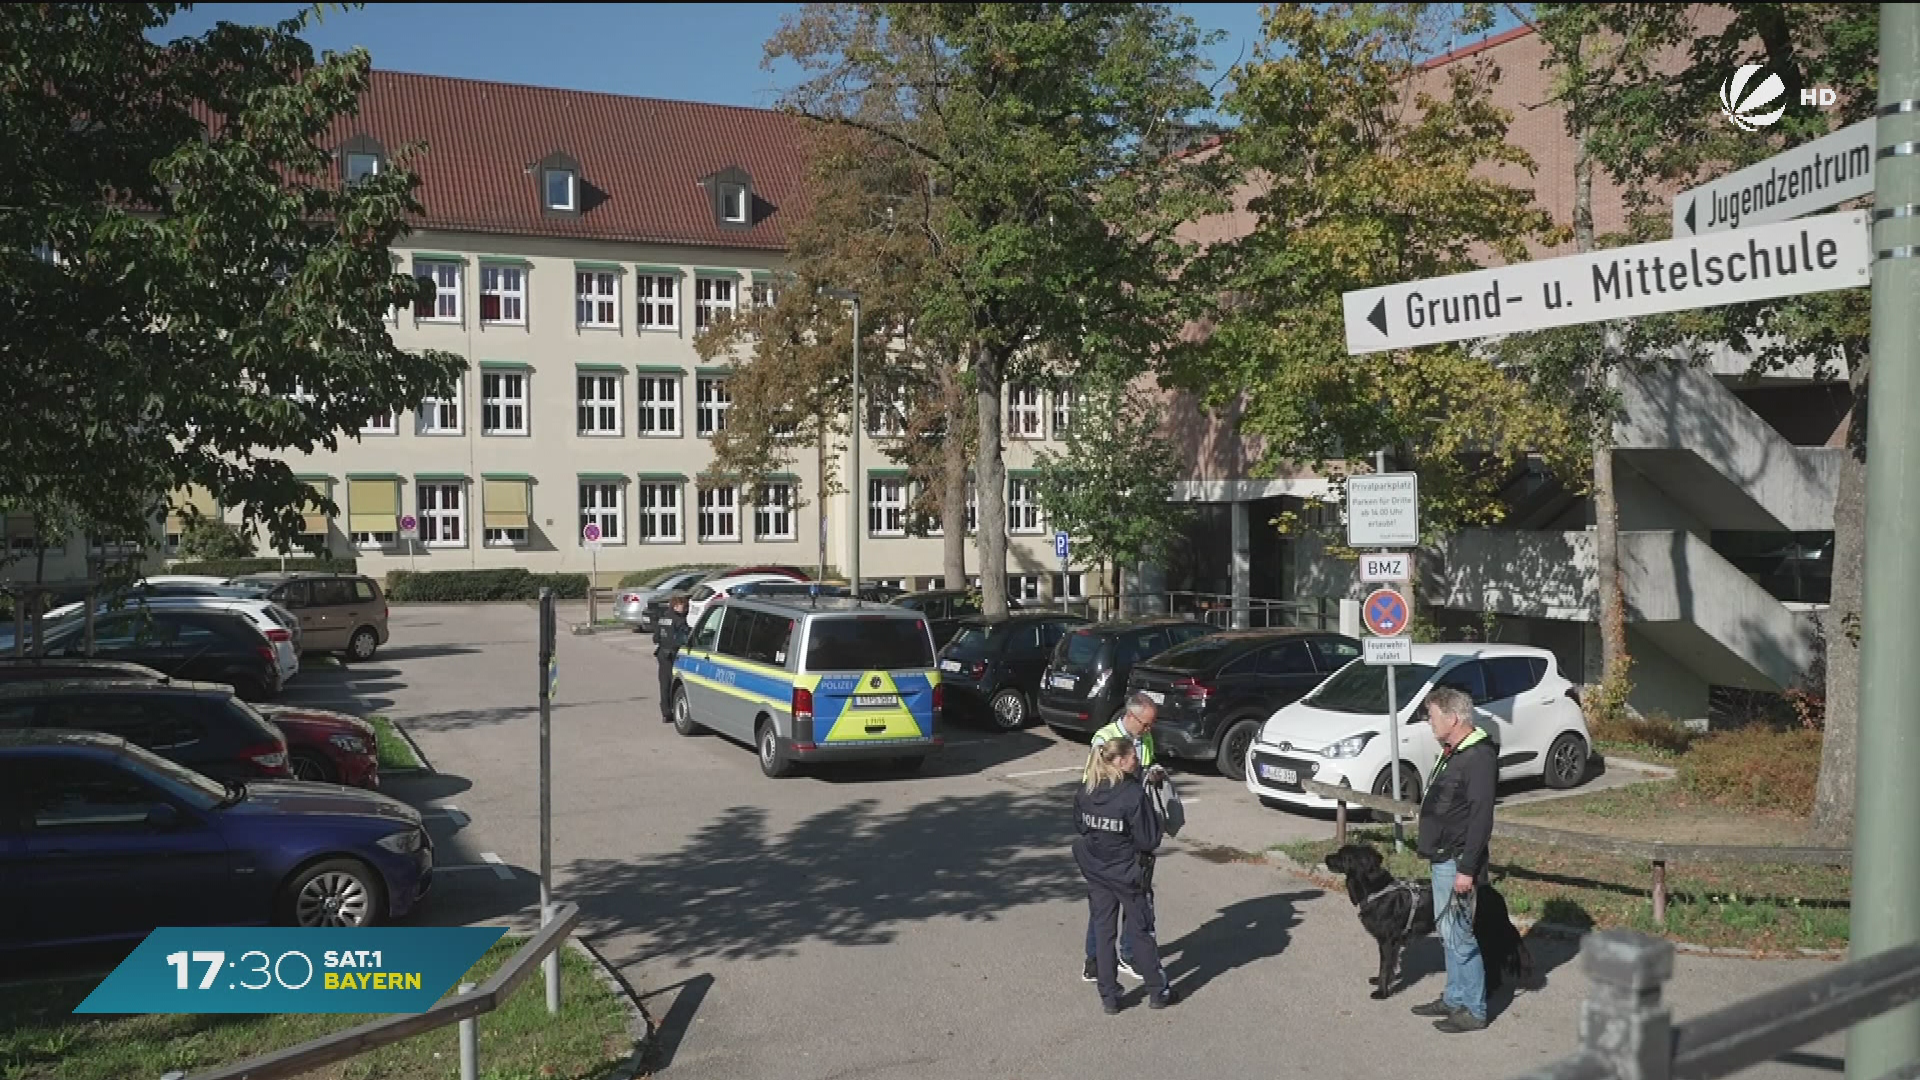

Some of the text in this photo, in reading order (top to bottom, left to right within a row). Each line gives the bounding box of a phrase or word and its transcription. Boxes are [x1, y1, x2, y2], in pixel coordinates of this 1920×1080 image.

[1707, 143, 1870, 229] Jugendzentrum
[1405, 229, 1839, 329] Grund- u. Mittelschule
[1352, 482, 1411, 491] Privatparkplatz
[1368, 561, 1402, 576] BMZ
[1376, 652, 1400, 660] zufahrt
[820, 680, 853, 690] POLIZEI
